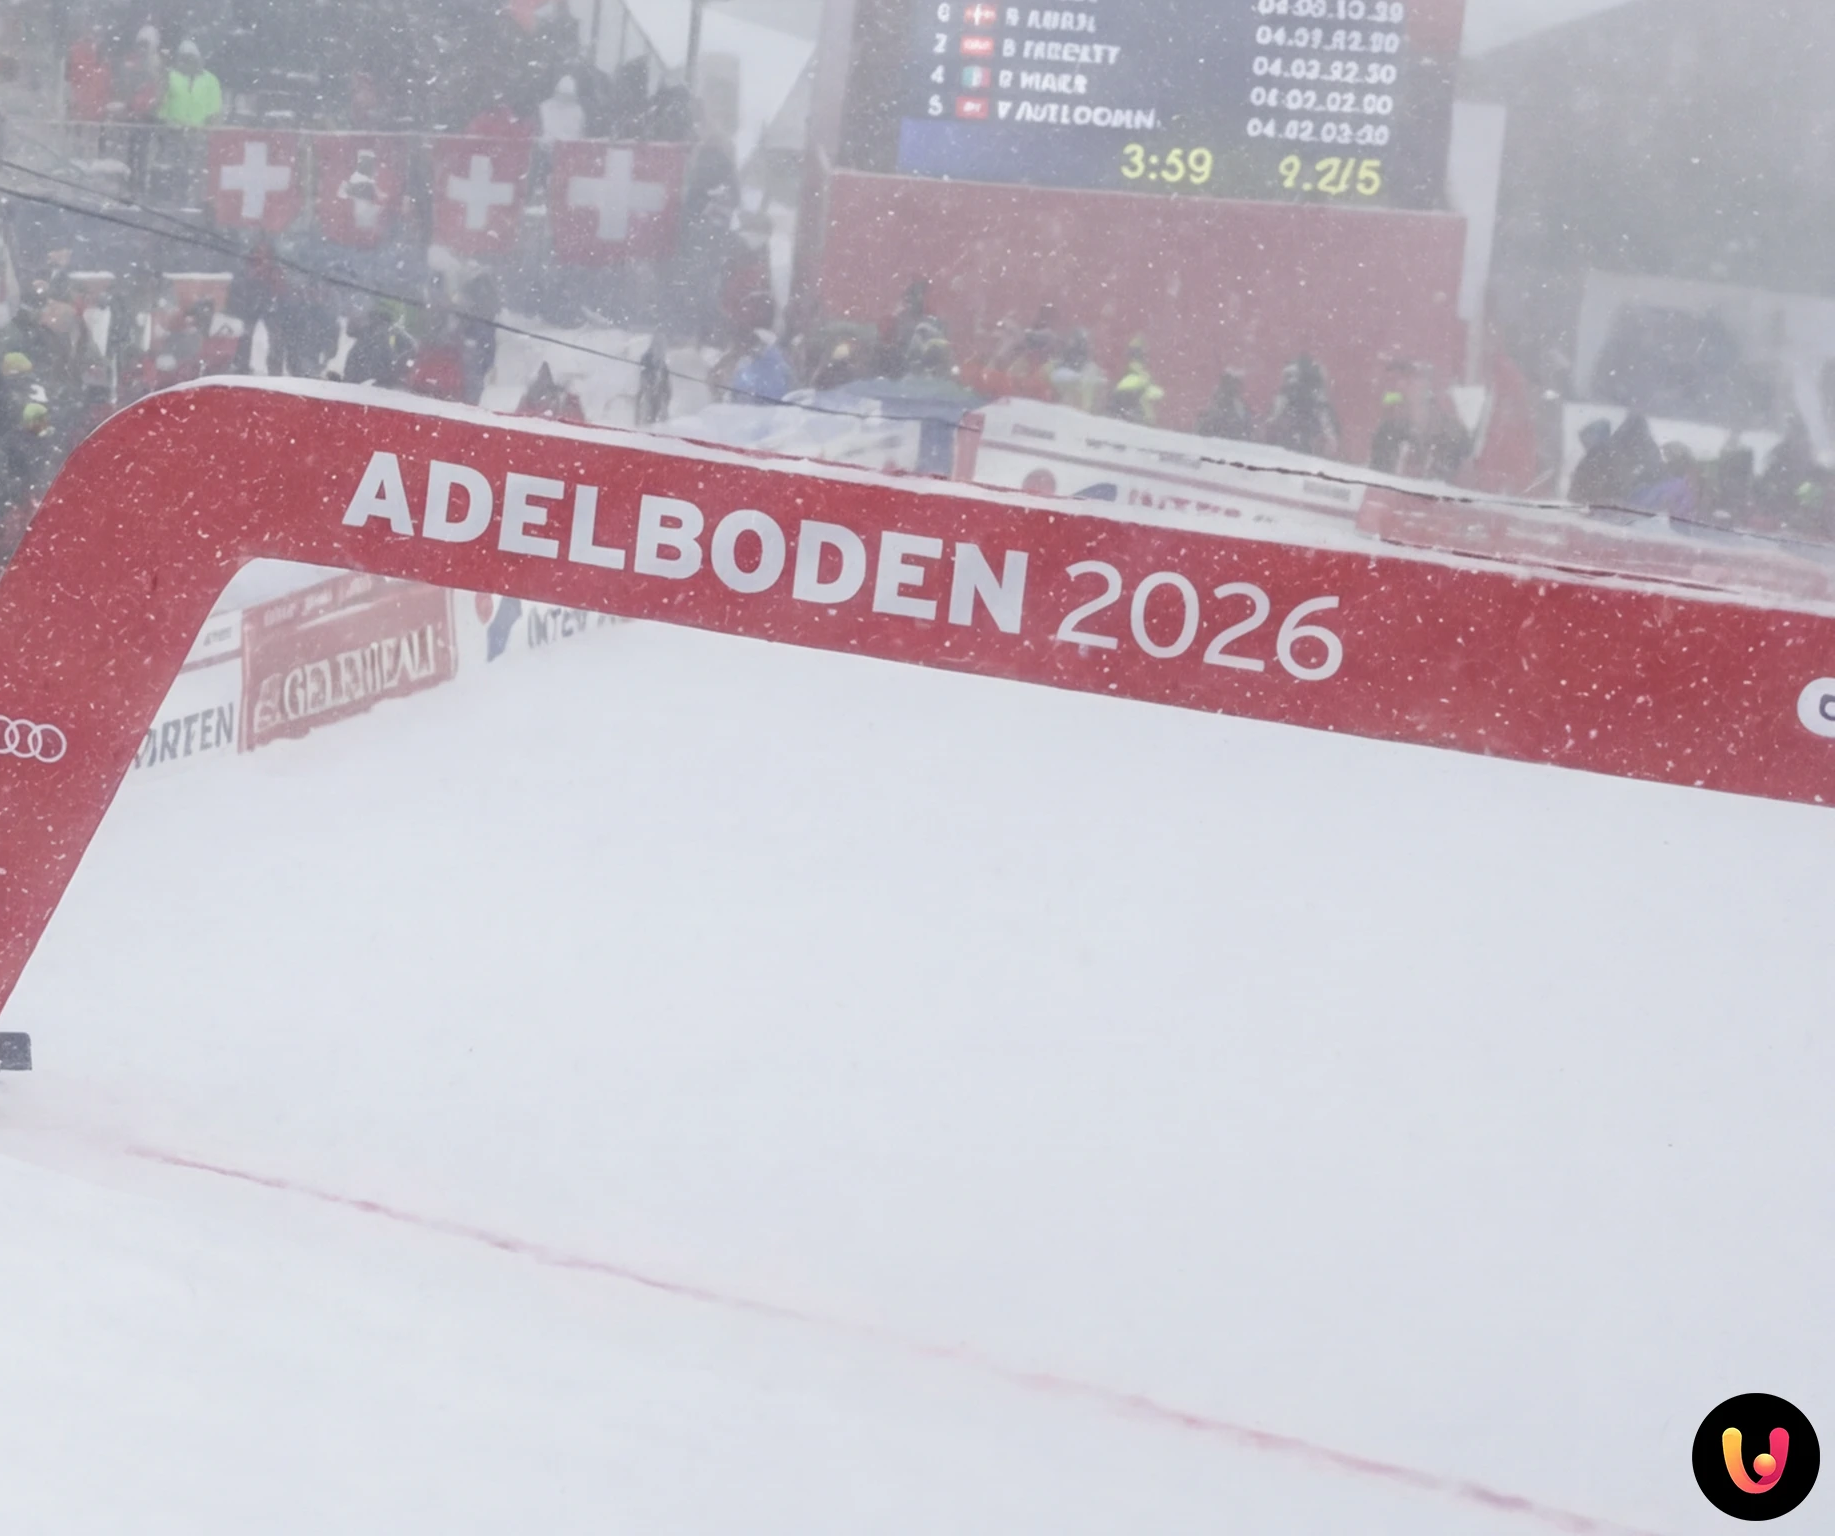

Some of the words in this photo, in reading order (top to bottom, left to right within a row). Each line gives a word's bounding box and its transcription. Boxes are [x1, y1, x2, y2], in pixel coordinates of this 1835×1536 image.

[1120, 143, 1214, 185] 3:59
[341, 450, 1029, 635] ADELBODEN
[1055, 559, 1344, 682] 2026
